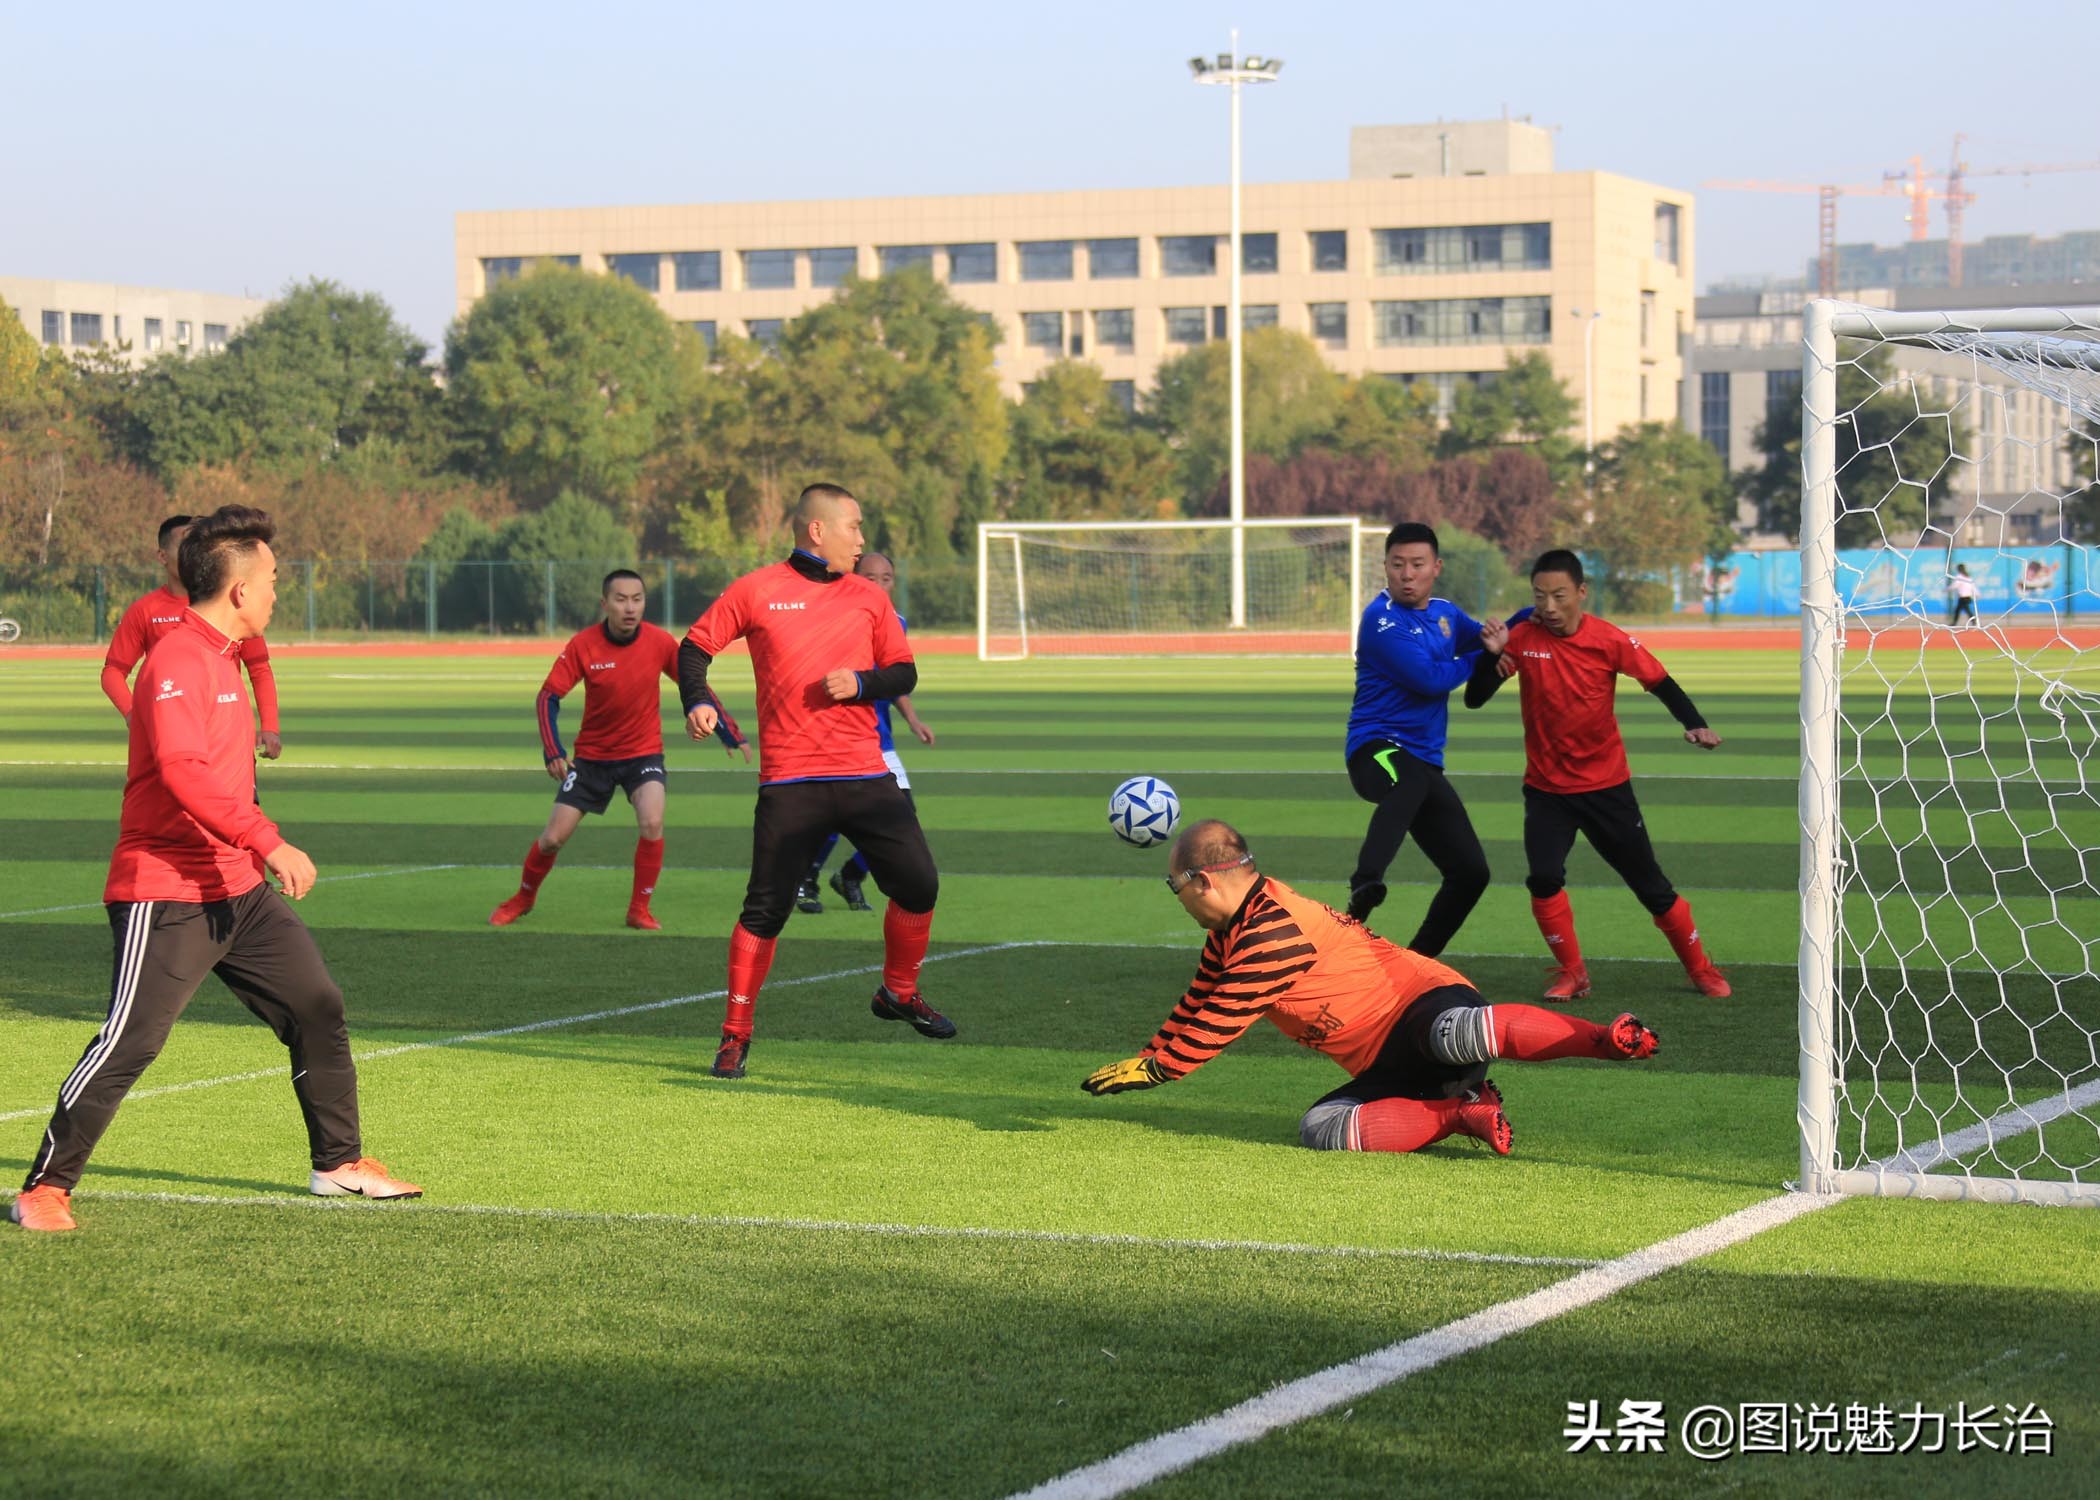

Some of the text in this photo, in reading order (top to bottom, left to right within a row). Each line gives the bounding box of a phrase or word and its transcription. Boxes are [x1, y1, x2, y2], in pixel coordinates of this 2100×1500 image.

[768, 602, 806, 611] KELME
[152, 616, 181, 624] KELME
[1522, 650, 1552, 660] KELME
[590, 662, 616, 670] KELME
[563, 771, 578, 793] 8
